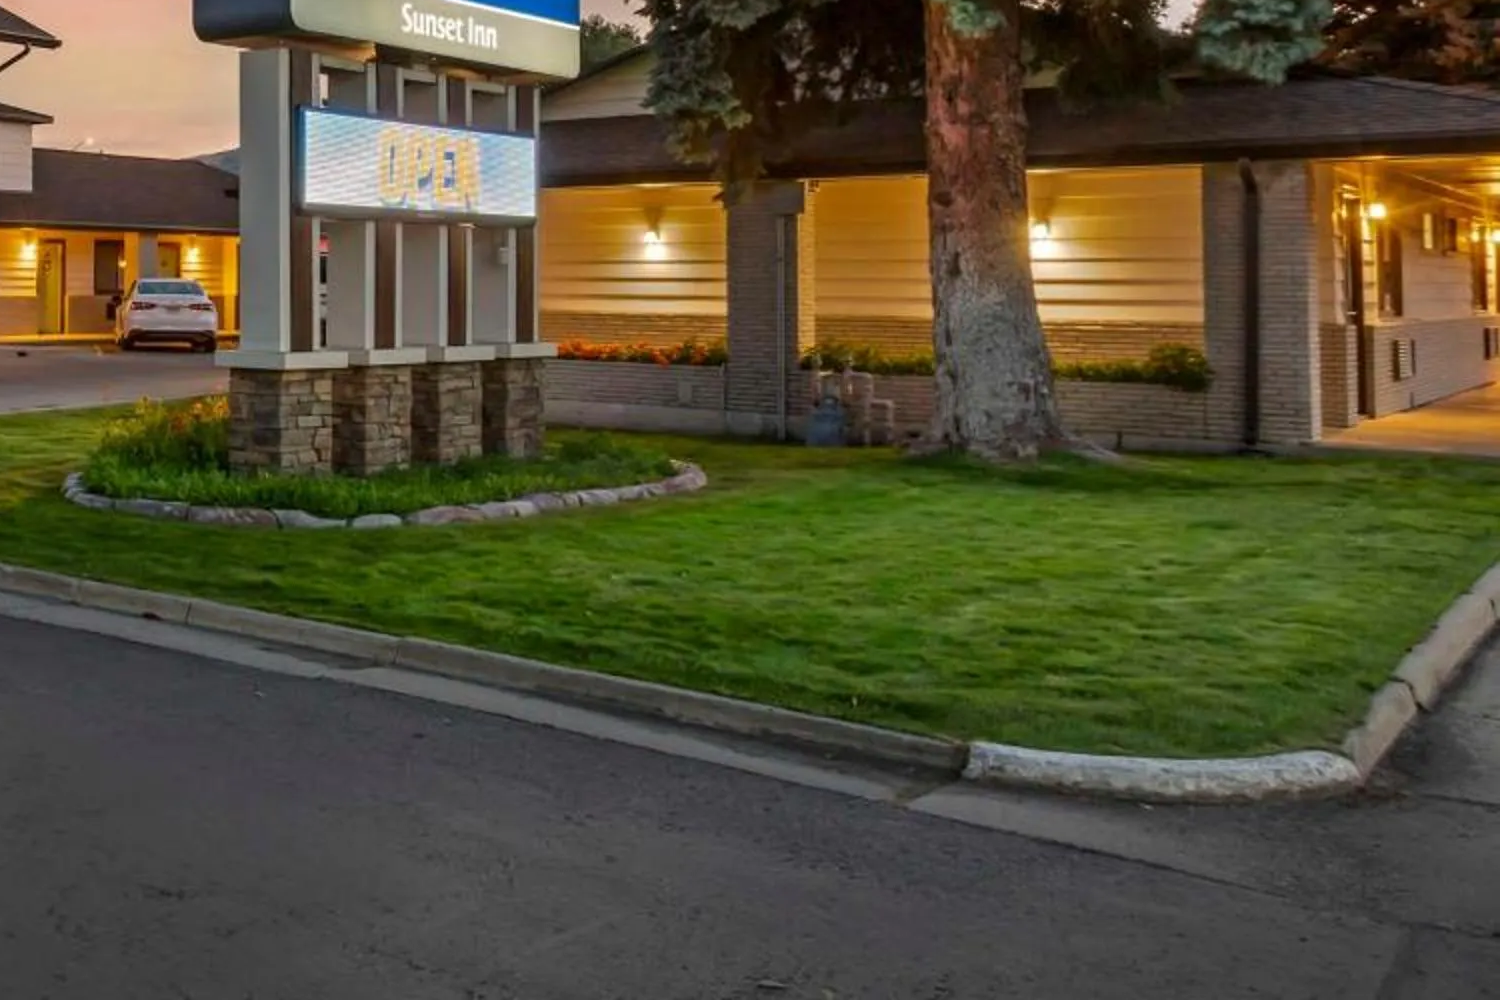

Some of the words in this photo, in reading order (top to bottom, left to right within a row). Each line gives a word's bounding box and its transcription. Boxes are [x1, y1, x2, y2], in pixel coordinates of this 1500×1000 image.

[401, 3, 465, 44] Sunset
[467, 16, 498, 50] Inn
[377, 128, 481, 208] OPEN
